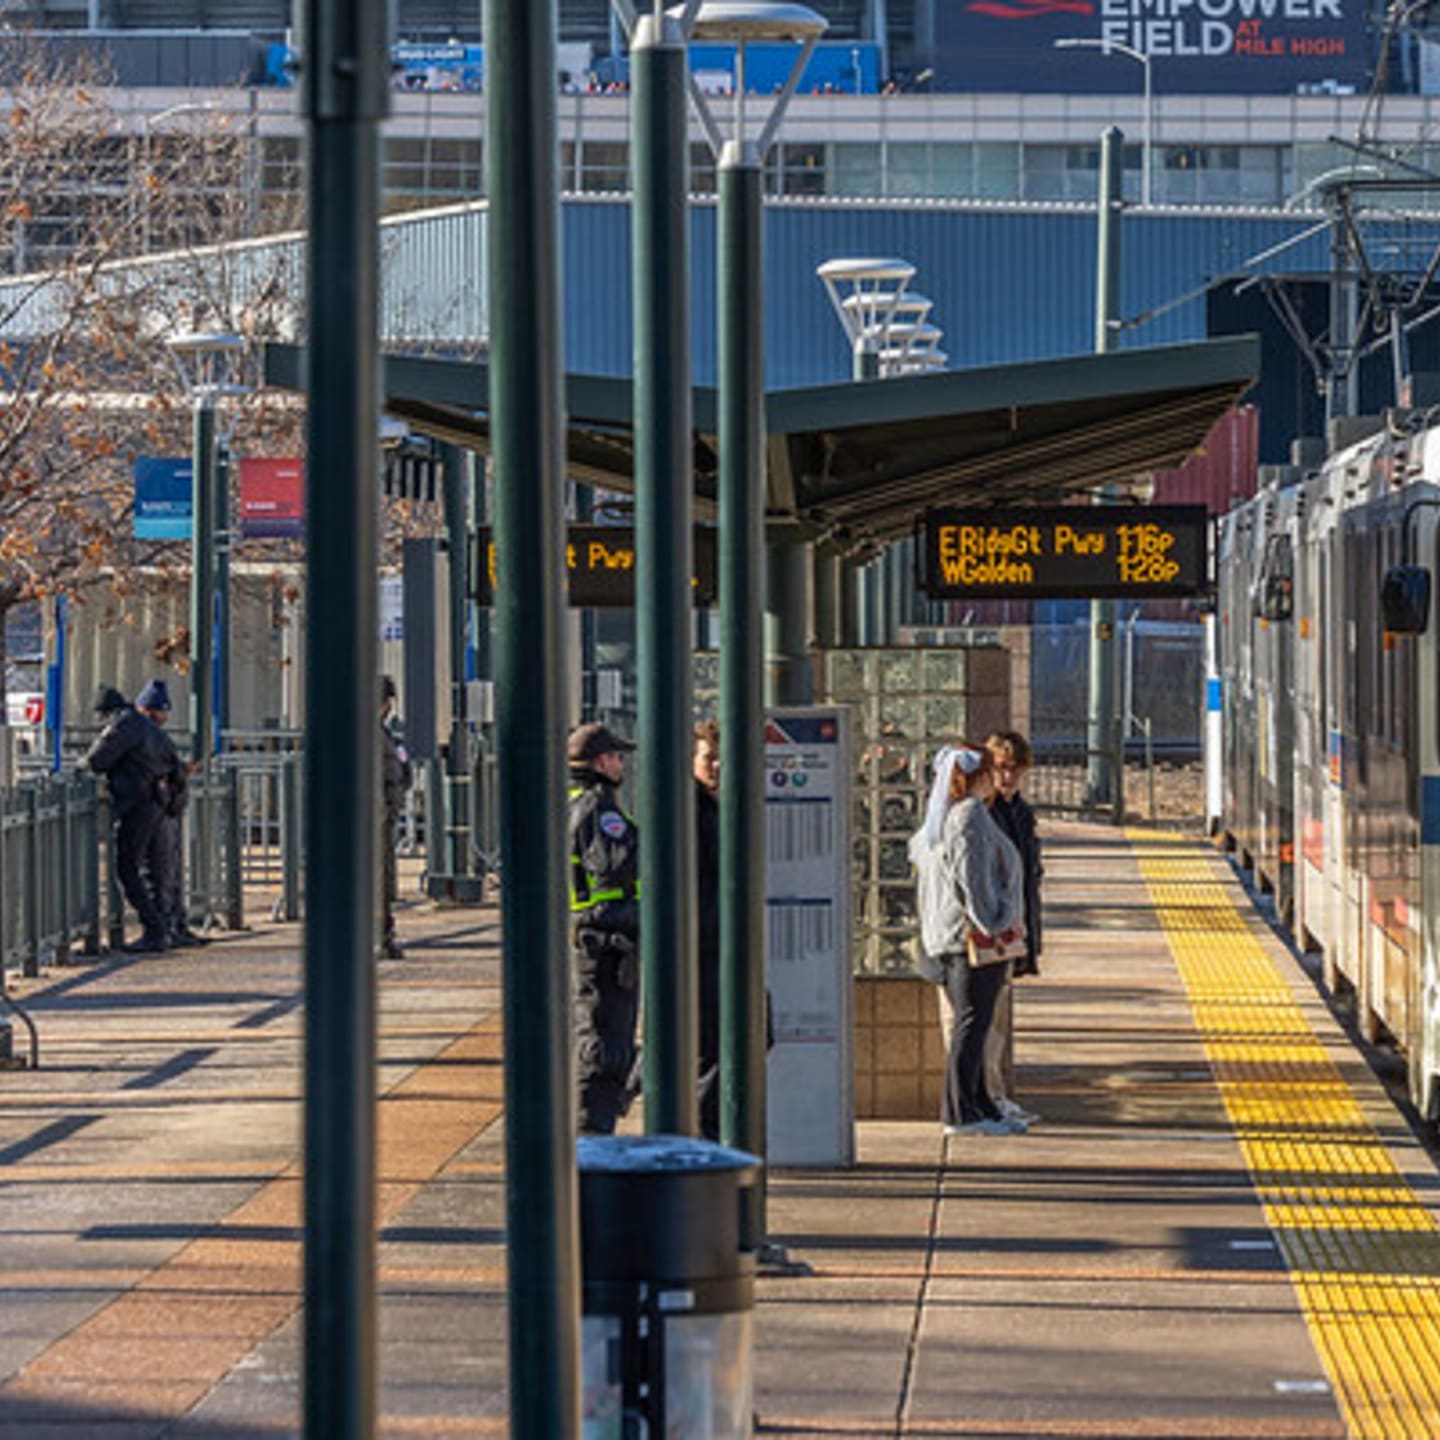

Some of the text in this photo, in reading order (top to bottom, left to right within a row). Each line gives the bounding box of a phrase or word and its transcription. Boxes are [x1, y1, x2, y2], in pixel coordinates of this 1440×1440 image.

[1102, 21, 1234, 55] FIELD
[1236, 20, 1262, 36] AT
[1236, 39, 1345, 55] MILE HIGH
[1054, 525, 1105, 555] Pwy
